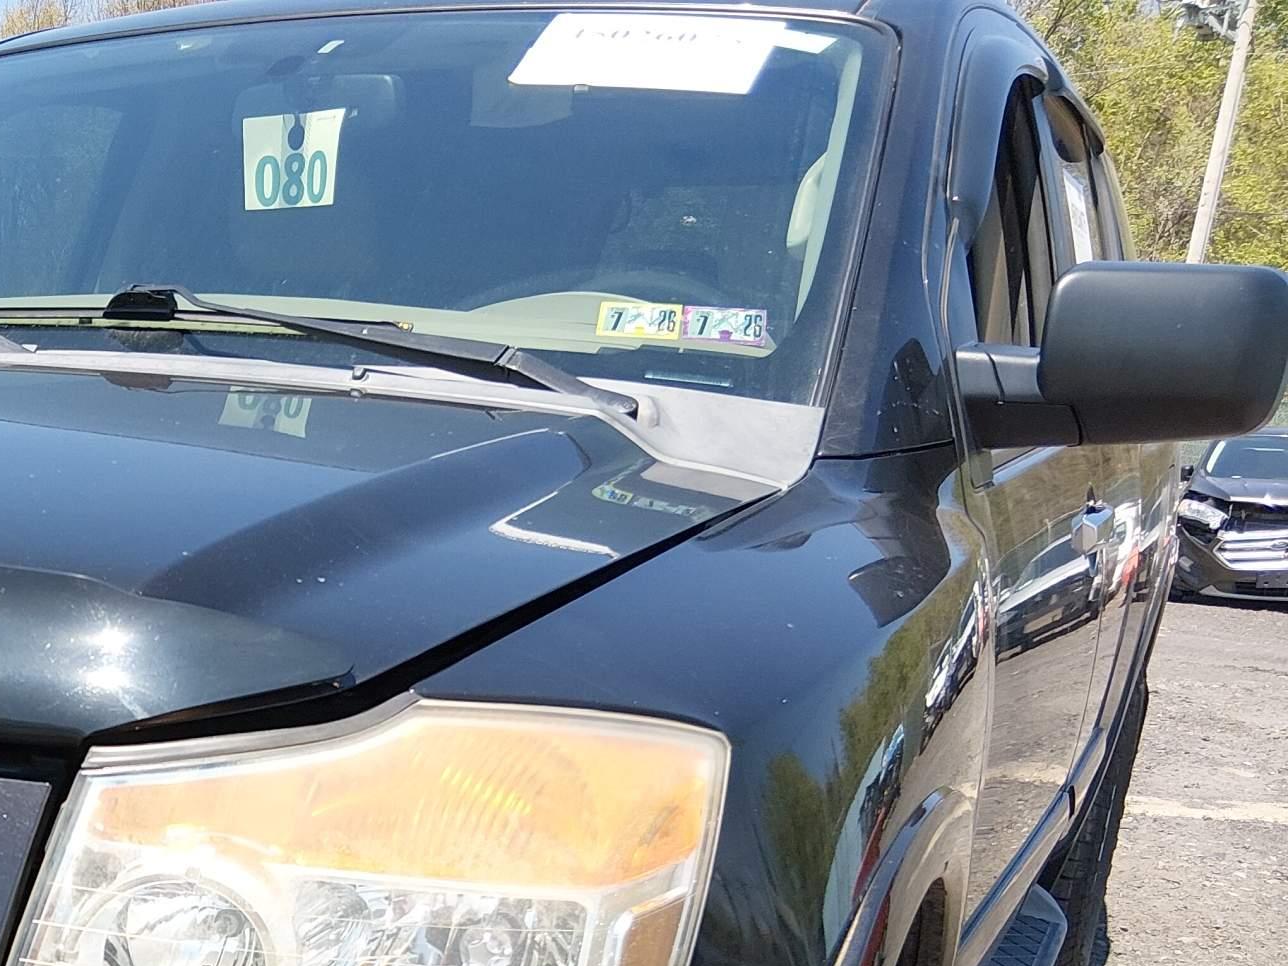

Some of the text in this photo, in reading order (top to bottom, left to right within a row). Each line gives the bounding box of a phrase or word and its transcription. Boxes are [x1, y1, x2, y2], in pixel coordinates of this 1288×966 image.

[255, 149, 328, 208] 080
[611, 309, 677, 333] 7 26
[697, 314, 709, 336] 7
